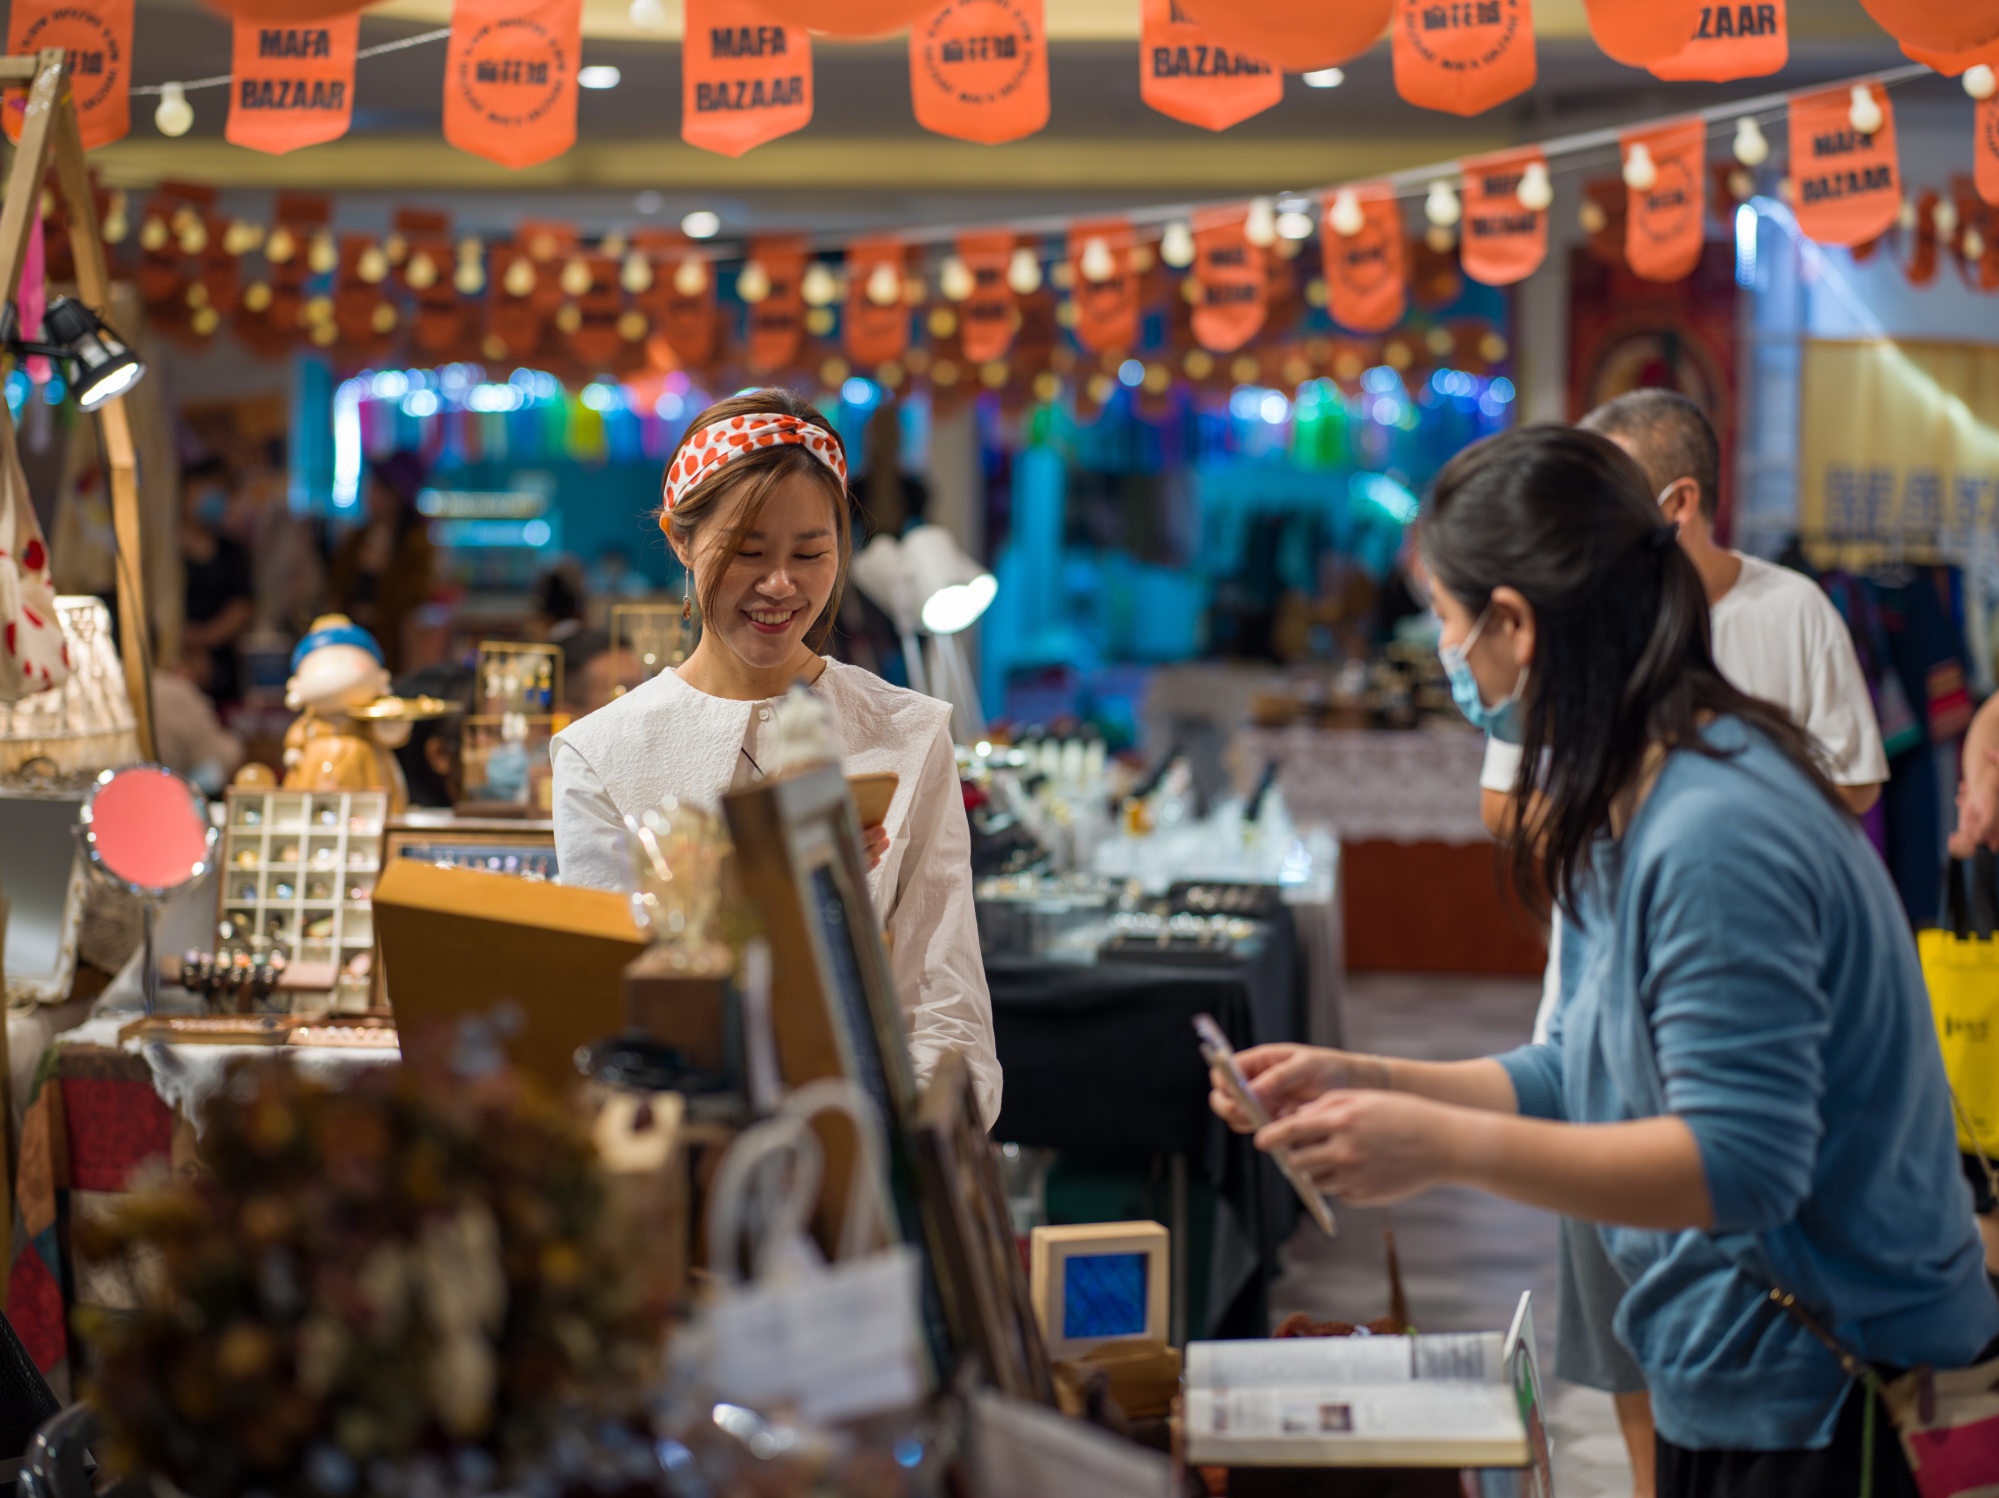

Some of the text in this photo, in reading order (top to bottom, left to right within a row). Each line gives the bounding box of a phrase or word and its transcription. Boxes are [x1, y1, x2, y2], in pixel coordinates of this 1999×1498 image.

[1692, 4, 1776, 40] ZAAR
[259, 29, 330, 58] MAFA
[710, 26, 786, 58] MAFA
[240, 79, 345, 109] BAZAAR
[696, 76, 803, 112] BAZAAR
[1802, 165, 1892, 203] BAZAAR
